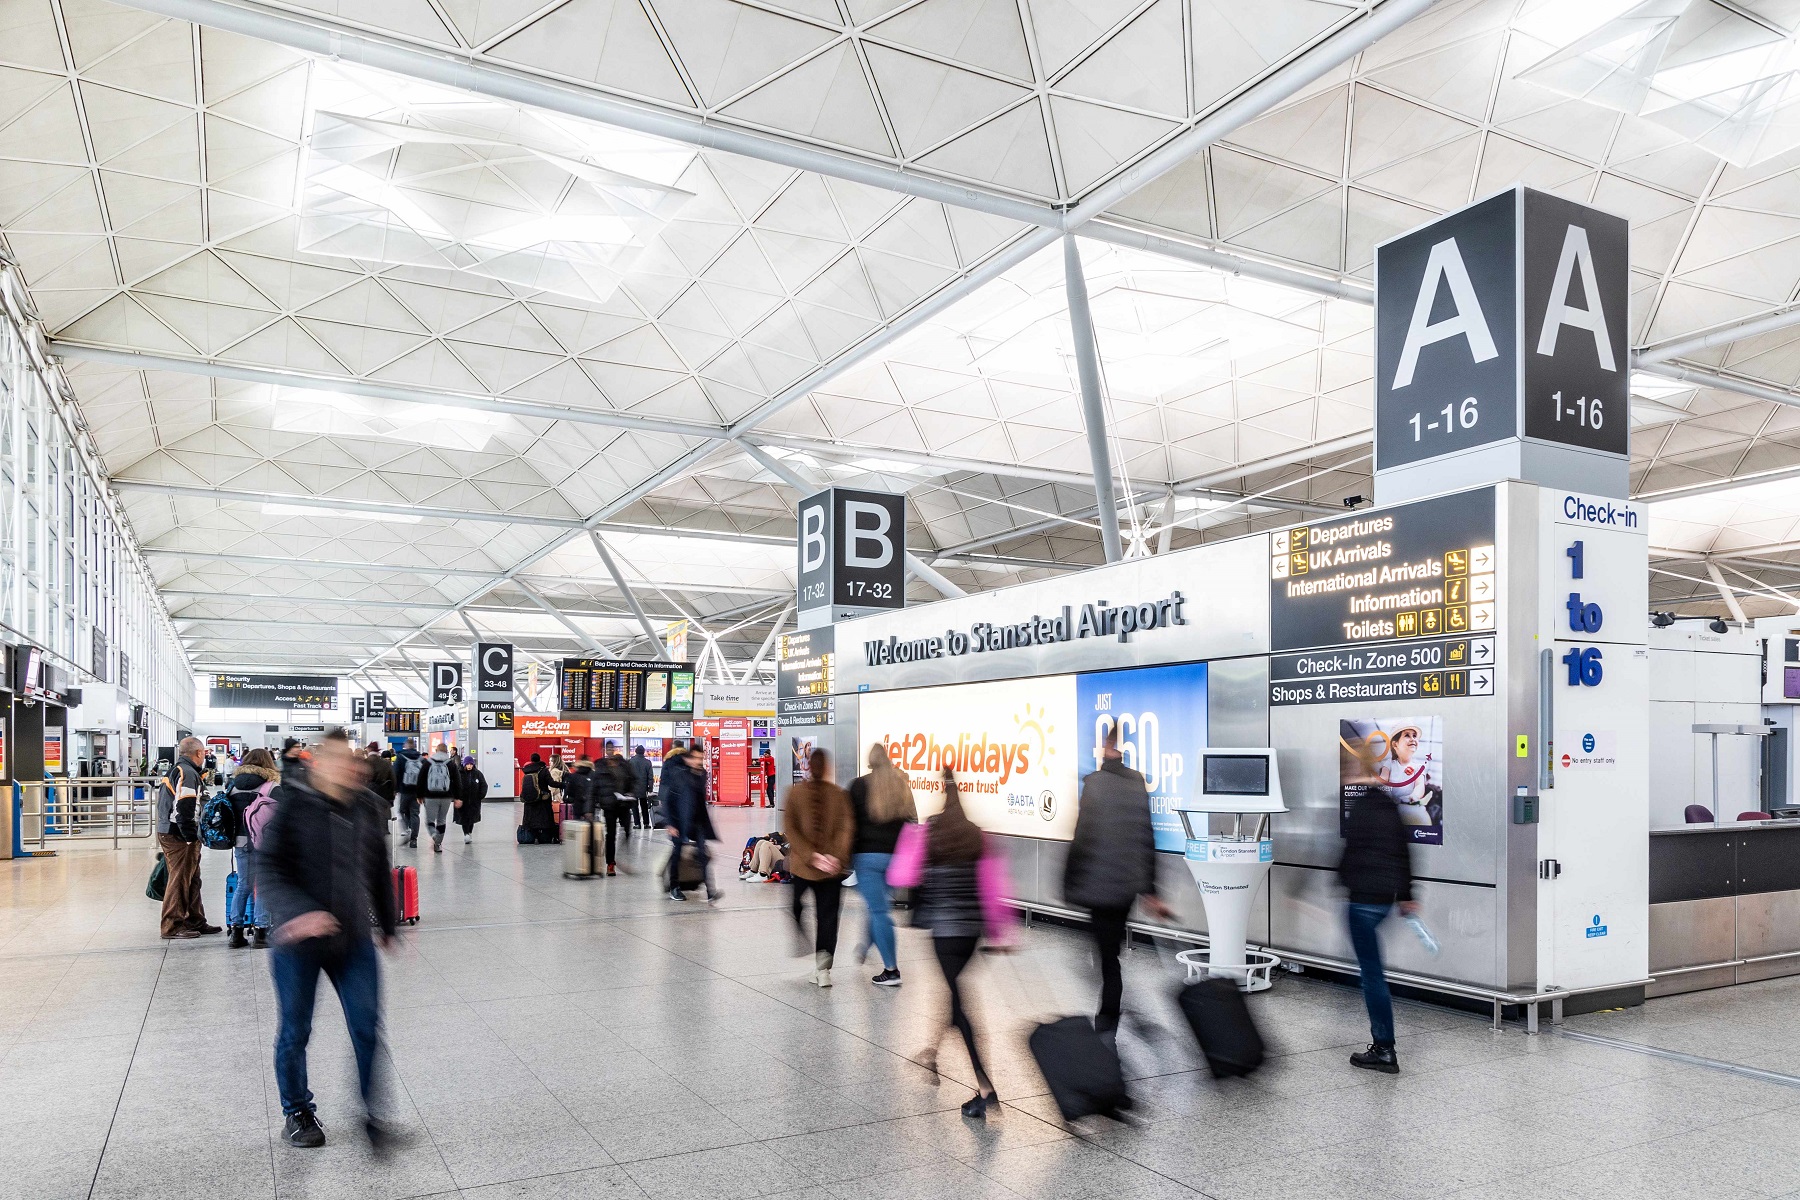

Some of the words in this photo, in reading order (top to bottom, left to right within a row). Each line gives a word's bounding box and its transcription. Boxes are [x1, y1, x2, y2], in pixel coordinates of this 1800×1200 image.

[1536, 223, 1617, 372] A
[1391, 236, 1500, 391] A
[1409, 397, 1479, 442] 1-16
[1552, 390, 1603, 430] 1-16
[1563, 495, 1637, 528] Check-in
[802, 504, 826, 574] B
[845, 499, 894, 569] B
[1310, 517, 1393, 546] Departures
[1310, 550, 1331, 570] UK
[1332, 541, 1392, 566] Arrivals
[1566, 540, 1583, 580] 1
[846, 580, 892, 599] 17-32
[1287, 568, 1377, 598] International
[1380, 558, 1442, 583] Arrivals
[803, 581, 825, 602] 17-32
[1350, 588, 1443, 614] Information
[1566, 592, 1603, 633] to
[788, 634, 810, 645] Departures
[863, 635, 941, 666] Welcome
[944, 629, 970, 656] to
[970, 605, 1071, 653] Stansted
[1076, 590, 1185, 643] Airport
[1343, 619, 1394, 640] Toilets
[482, 647, 509, 676] C
[594, 660, 606, 668] Bag
[1296, 655, 1362, 676] Check-In
[1366, 653, 1406, 669] Zone
[1410, 647, 1442, 665] 500
[1562, 647, 1603, 687] 16
[437, 665, 459, 689] D
[484, 680, 507, 688] 33-48
[370, 693, 383, 709] E
[802, 701, 813, 710] Zone
[813, 700, 821, 709] 500
[1094, 692, 1112, 711] JUST
[1272, 686, 1312, 704] Shops
[1316, 685, 1326, 699] &
[1330, 680, 1418, 698] Restaurants
[521, 721, 570, 730] Jet2.com
[602, 723, 656, 734] jet2olidays
[957, 780, 973, 792] can
[976, 779, 998, 794] trust
[1014, 794, 1035, 807] ABTA
[1186, 842, 1207, 853] FREE
